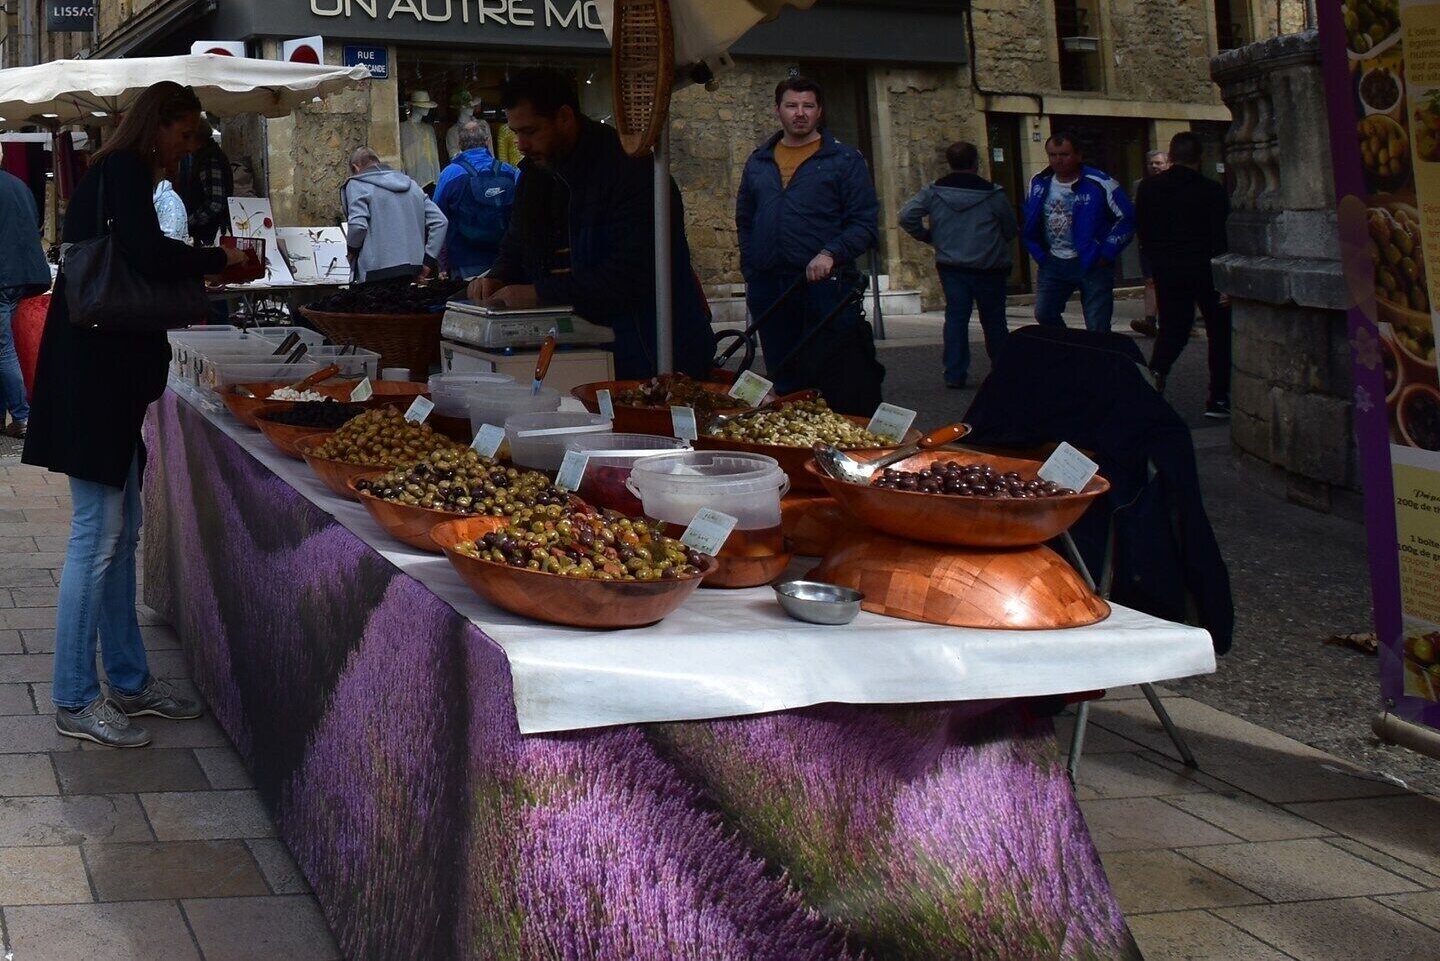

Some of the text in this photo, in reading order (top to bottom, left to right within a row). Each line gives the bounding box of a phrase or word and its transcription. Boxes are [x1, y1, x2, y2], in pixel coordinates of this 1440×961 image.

[357, 50, 375, 60] RUE
[1396, 497, 1420, 510] 200g
[1420, 503, 1432, 512] de
[1419, 549, 1431, 558] de
